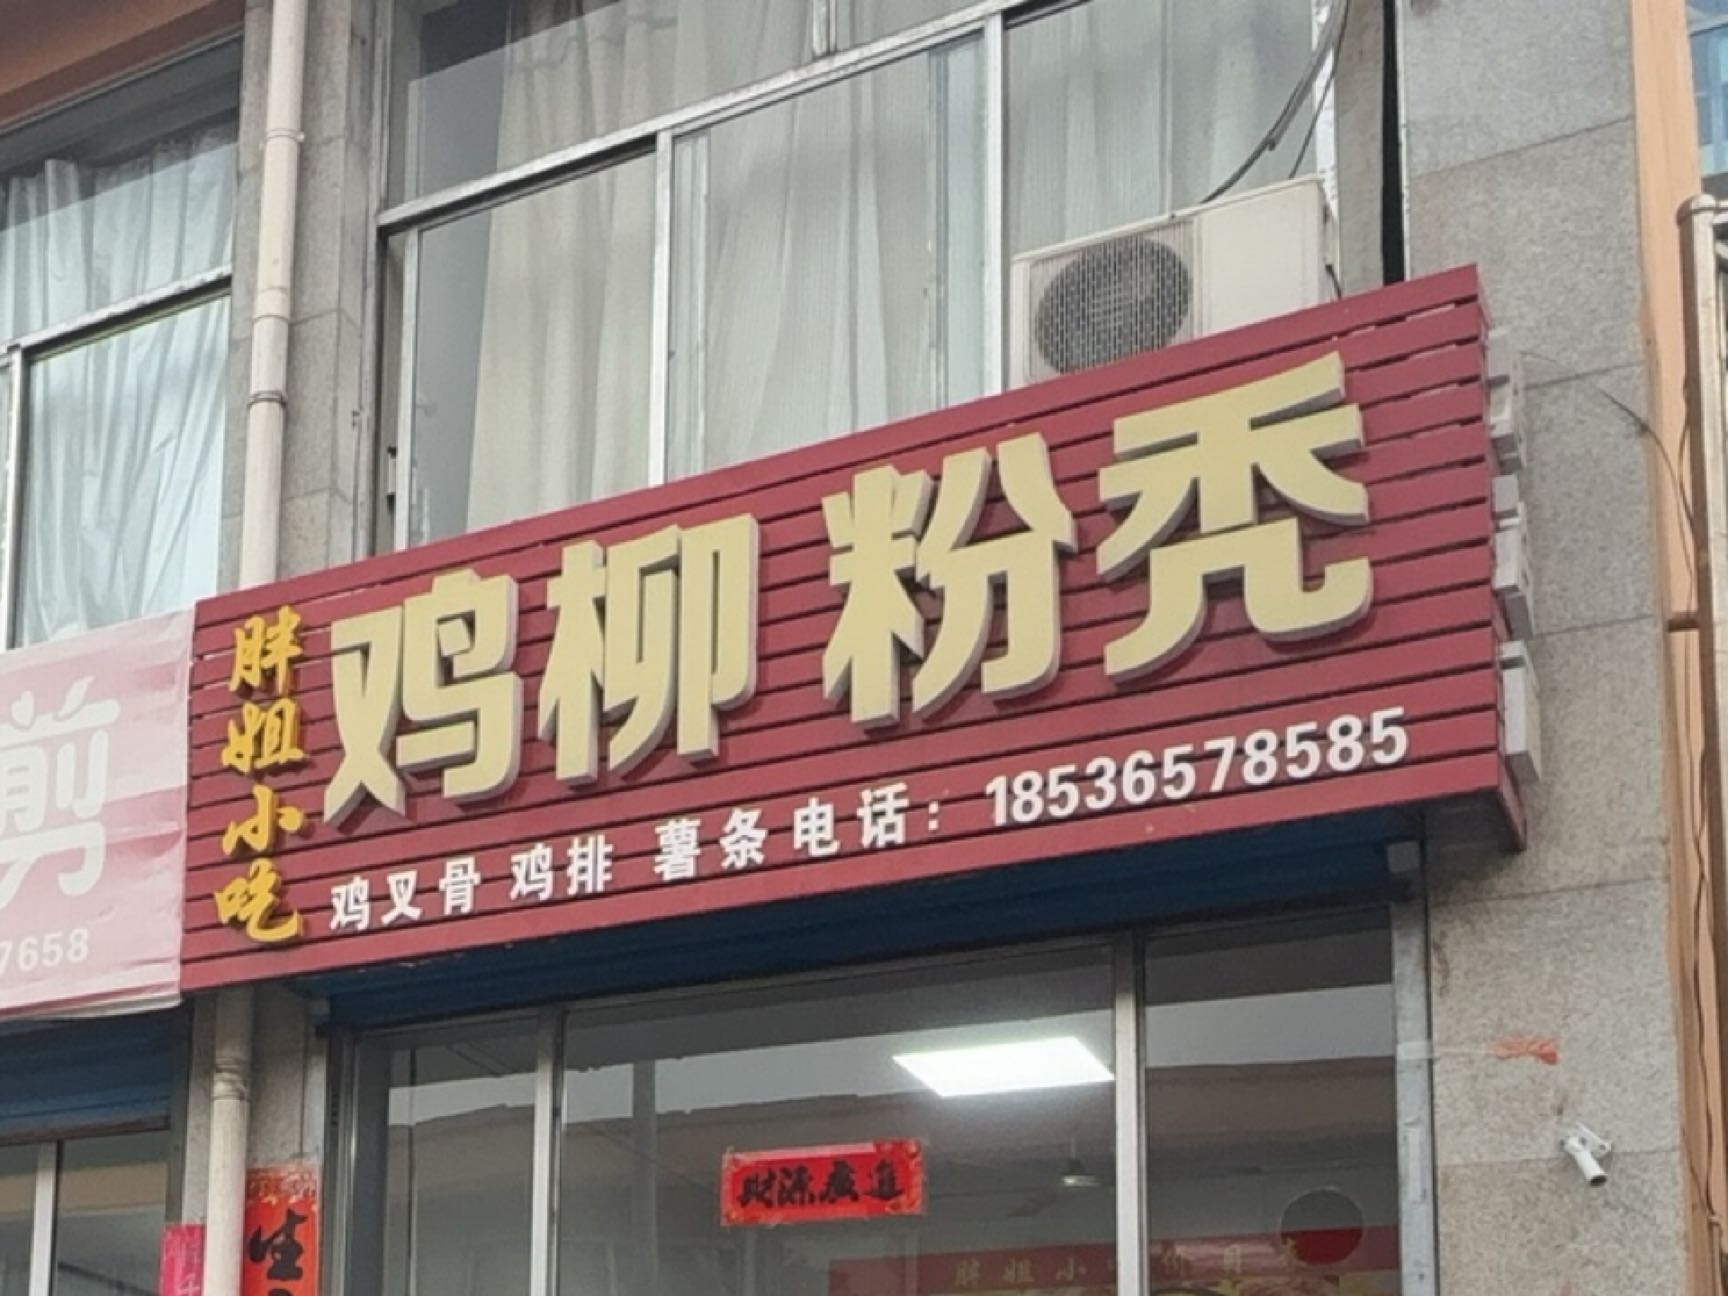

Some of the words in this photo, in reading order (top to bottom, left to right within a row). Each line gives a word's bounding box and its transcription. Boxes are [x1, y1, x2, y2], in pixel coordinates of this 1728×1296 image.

[216, 606, 305, 943] 胖姐小吃
[329, 853, 481, 931] 鸡叉骨
[509, 836, 614, 901] 鸡排
[652, 807, 769, 883] 薯条
[984, 706, 1409, 829] 18536578585
